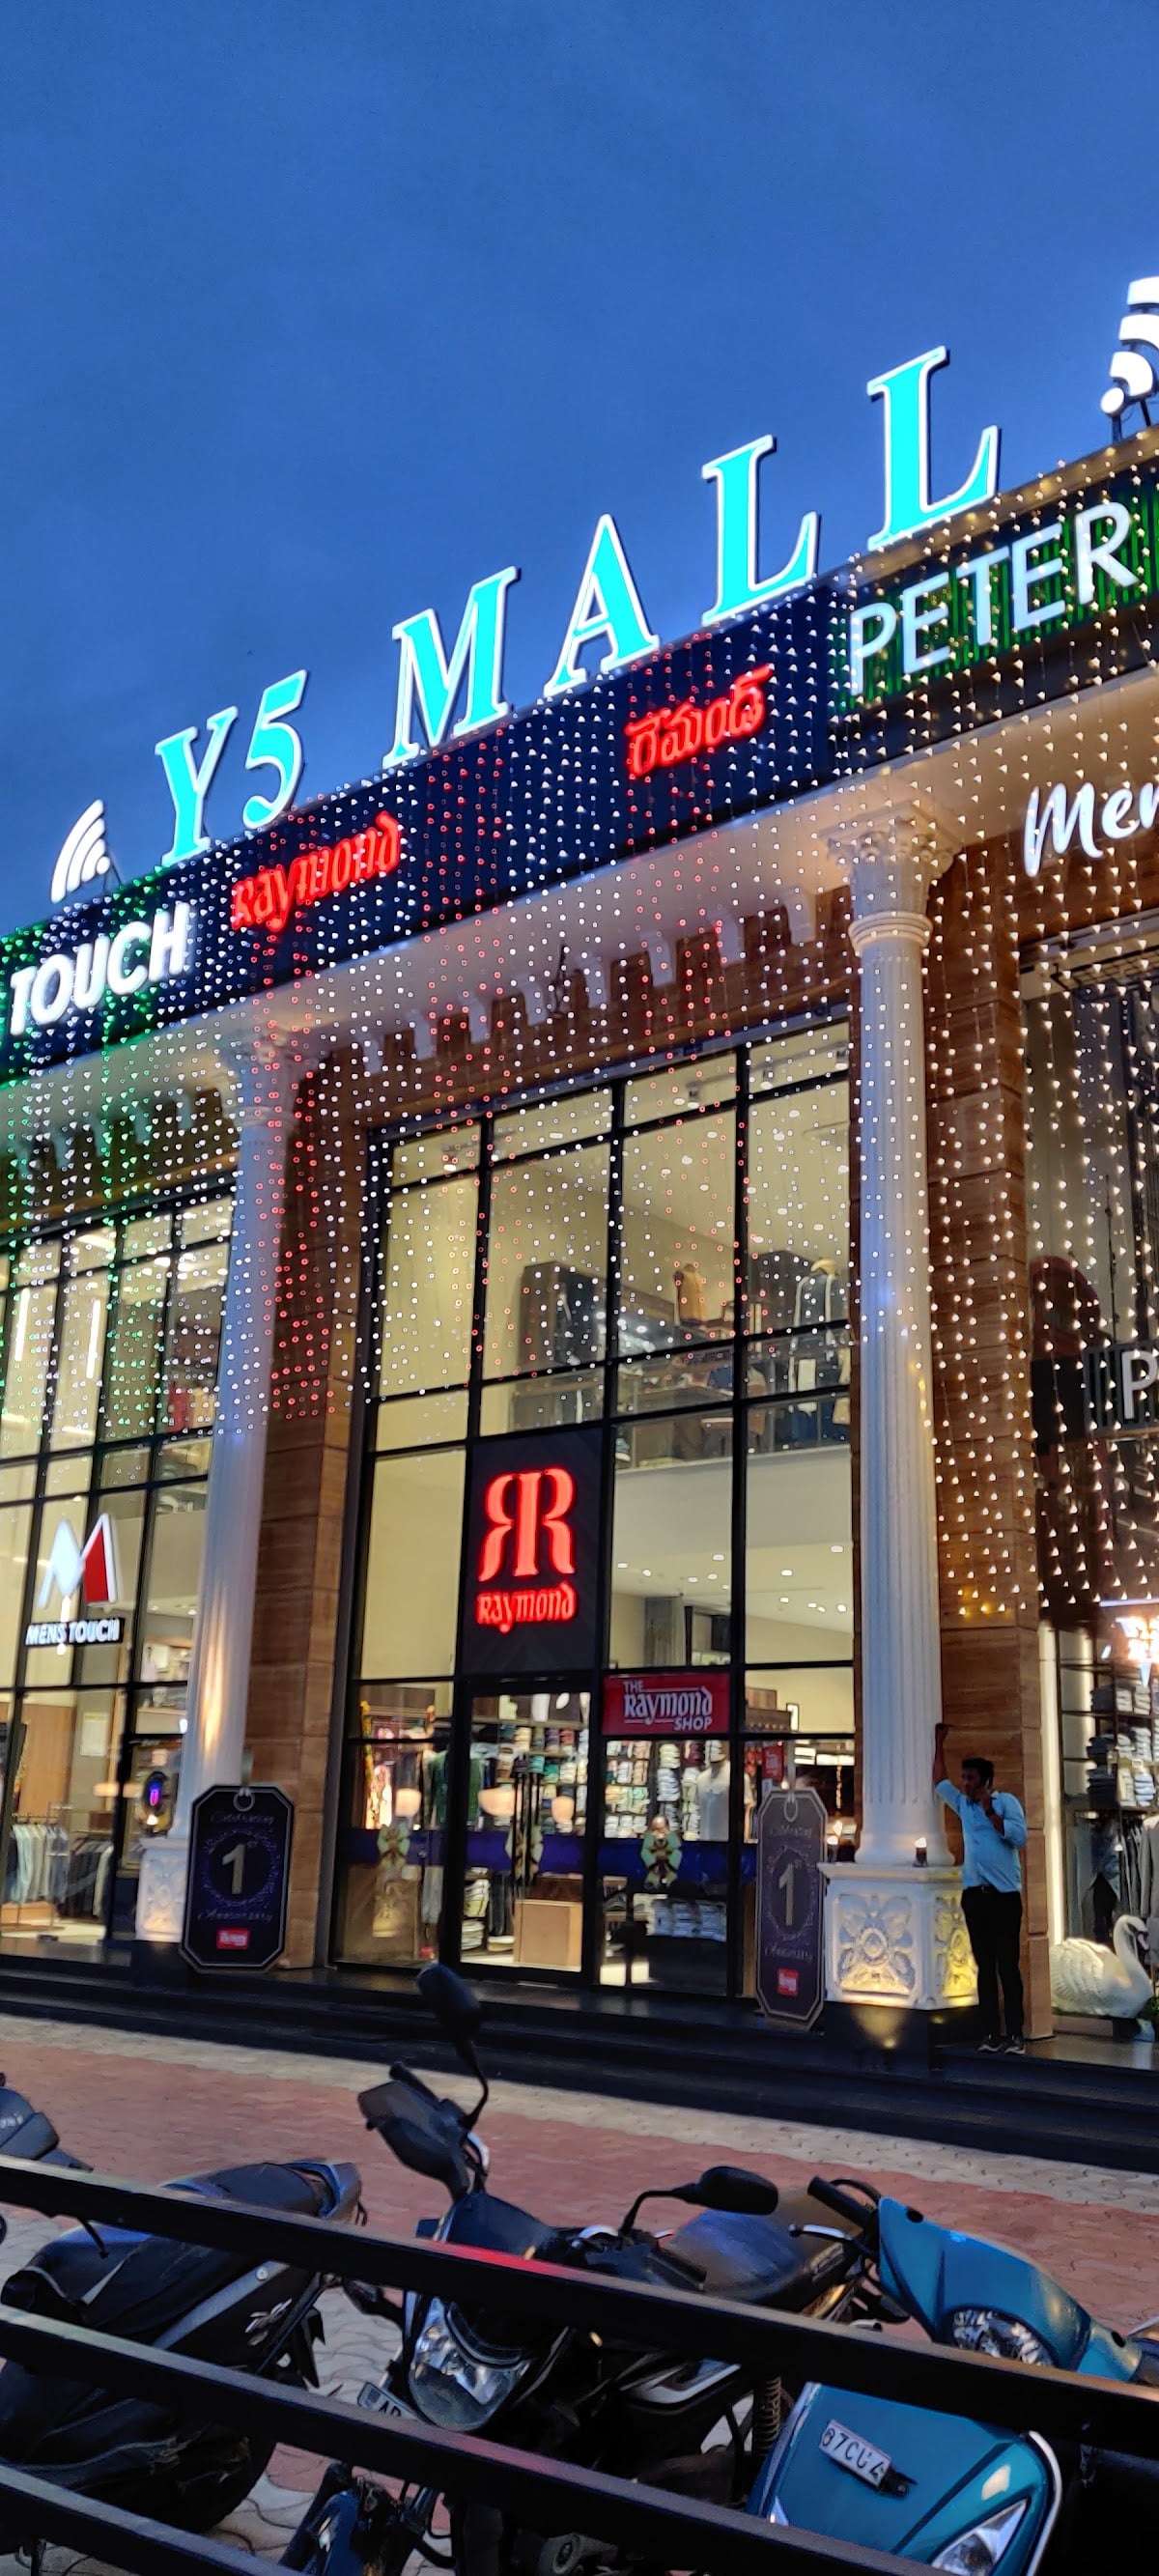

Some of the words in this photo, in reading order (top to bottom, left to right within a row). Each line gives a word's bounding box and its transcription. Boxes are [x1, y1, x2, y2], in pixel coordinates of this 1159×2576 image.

[155, 669, 309, 867] Y5
[382, 345, 1000, 770] MALL
[850, 501, 1140, 695] PETER
[10, 901, 191, 1035] TOUCH
[25, 1623, 67, 1645] MENS
[69, 1619, 120, 1642] TOUCH
[623, 1681, 643, 1693] THE
[624, 1685, 713, 1725] Raymond
[674, 1716, 713, 1731] SHOP
